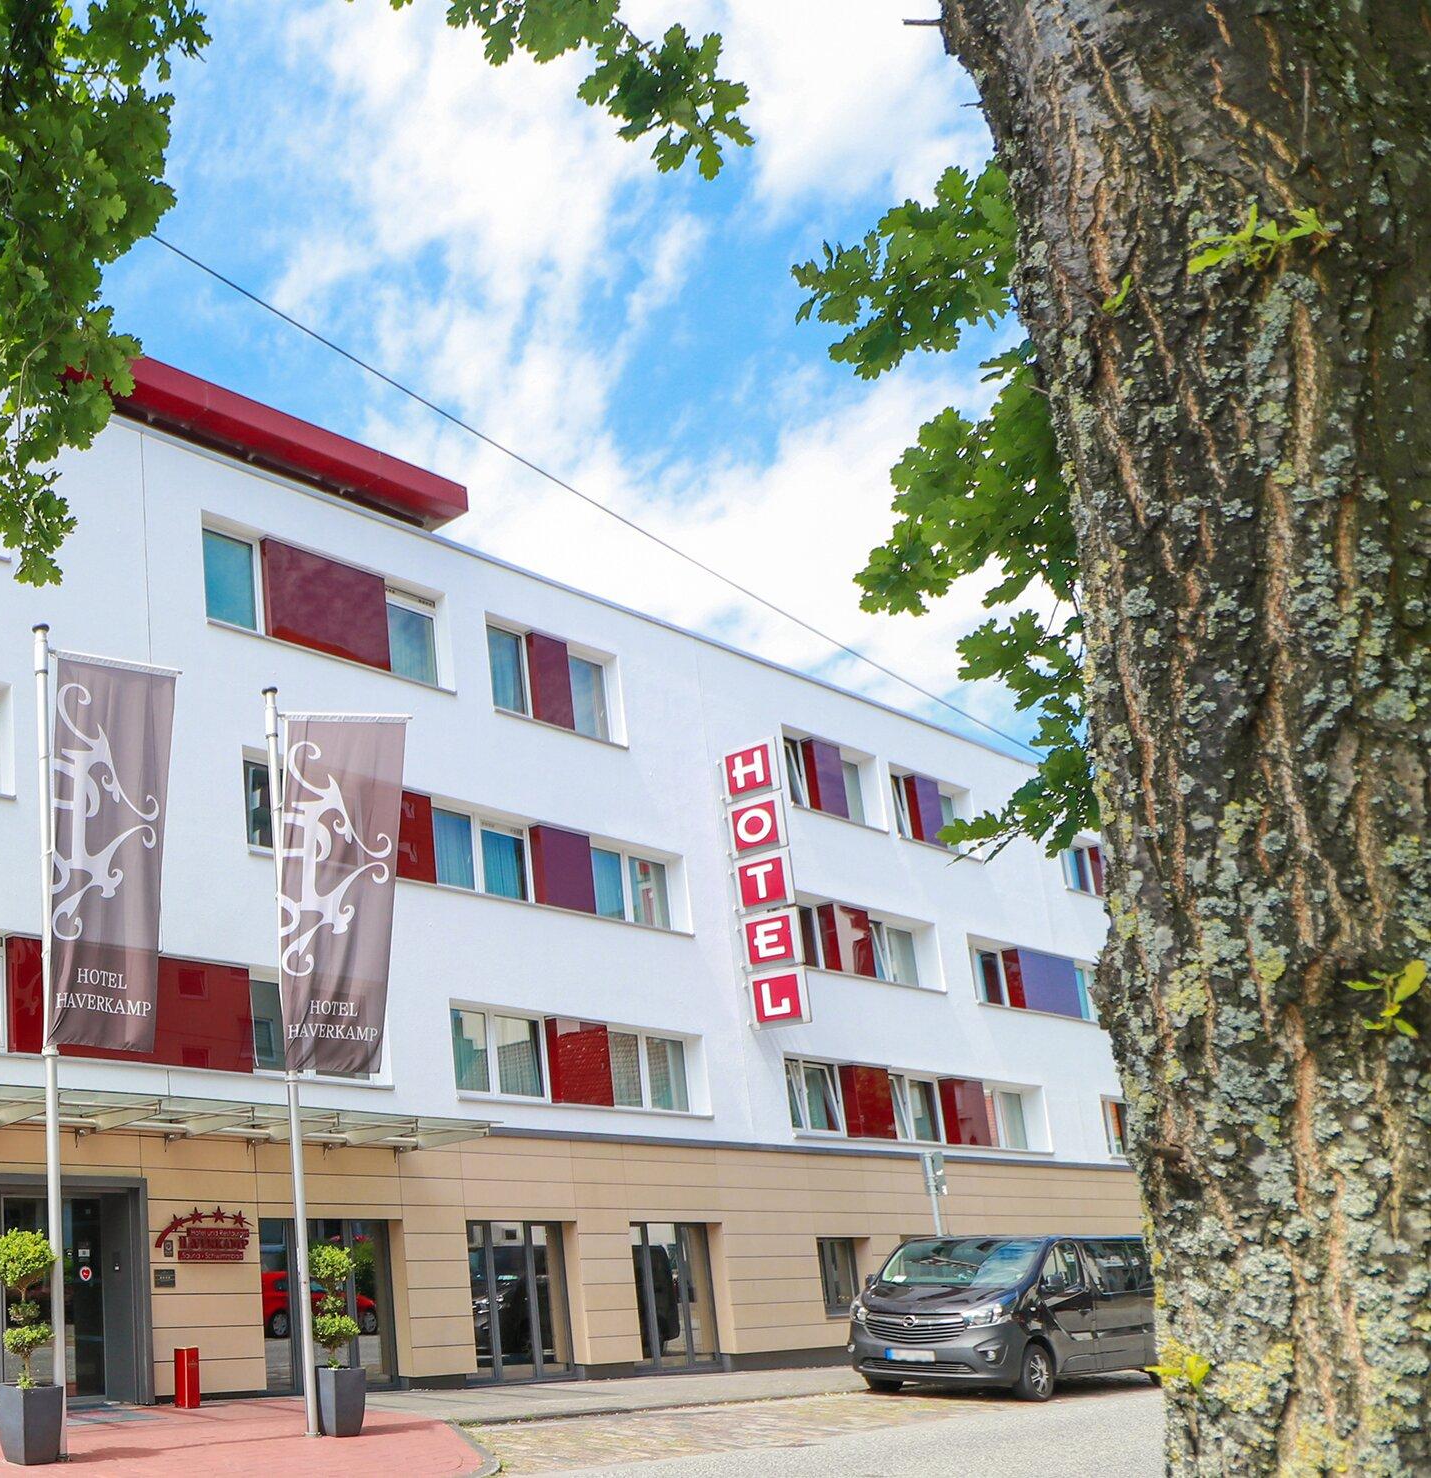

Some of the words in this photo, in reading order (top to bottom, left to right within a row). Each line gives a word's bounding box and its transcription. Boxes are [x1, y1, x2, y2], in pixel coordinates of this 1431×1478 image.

[732, 749, 791, 1017] HOTEL
[77, 968, 127, 989] HOTEL
[56, 992, 151, 1016] HAVERKAMP
[310, 1000, 358, 1016] HOTEL
[287, 1023, 378, 1041] HAVERKAMP
